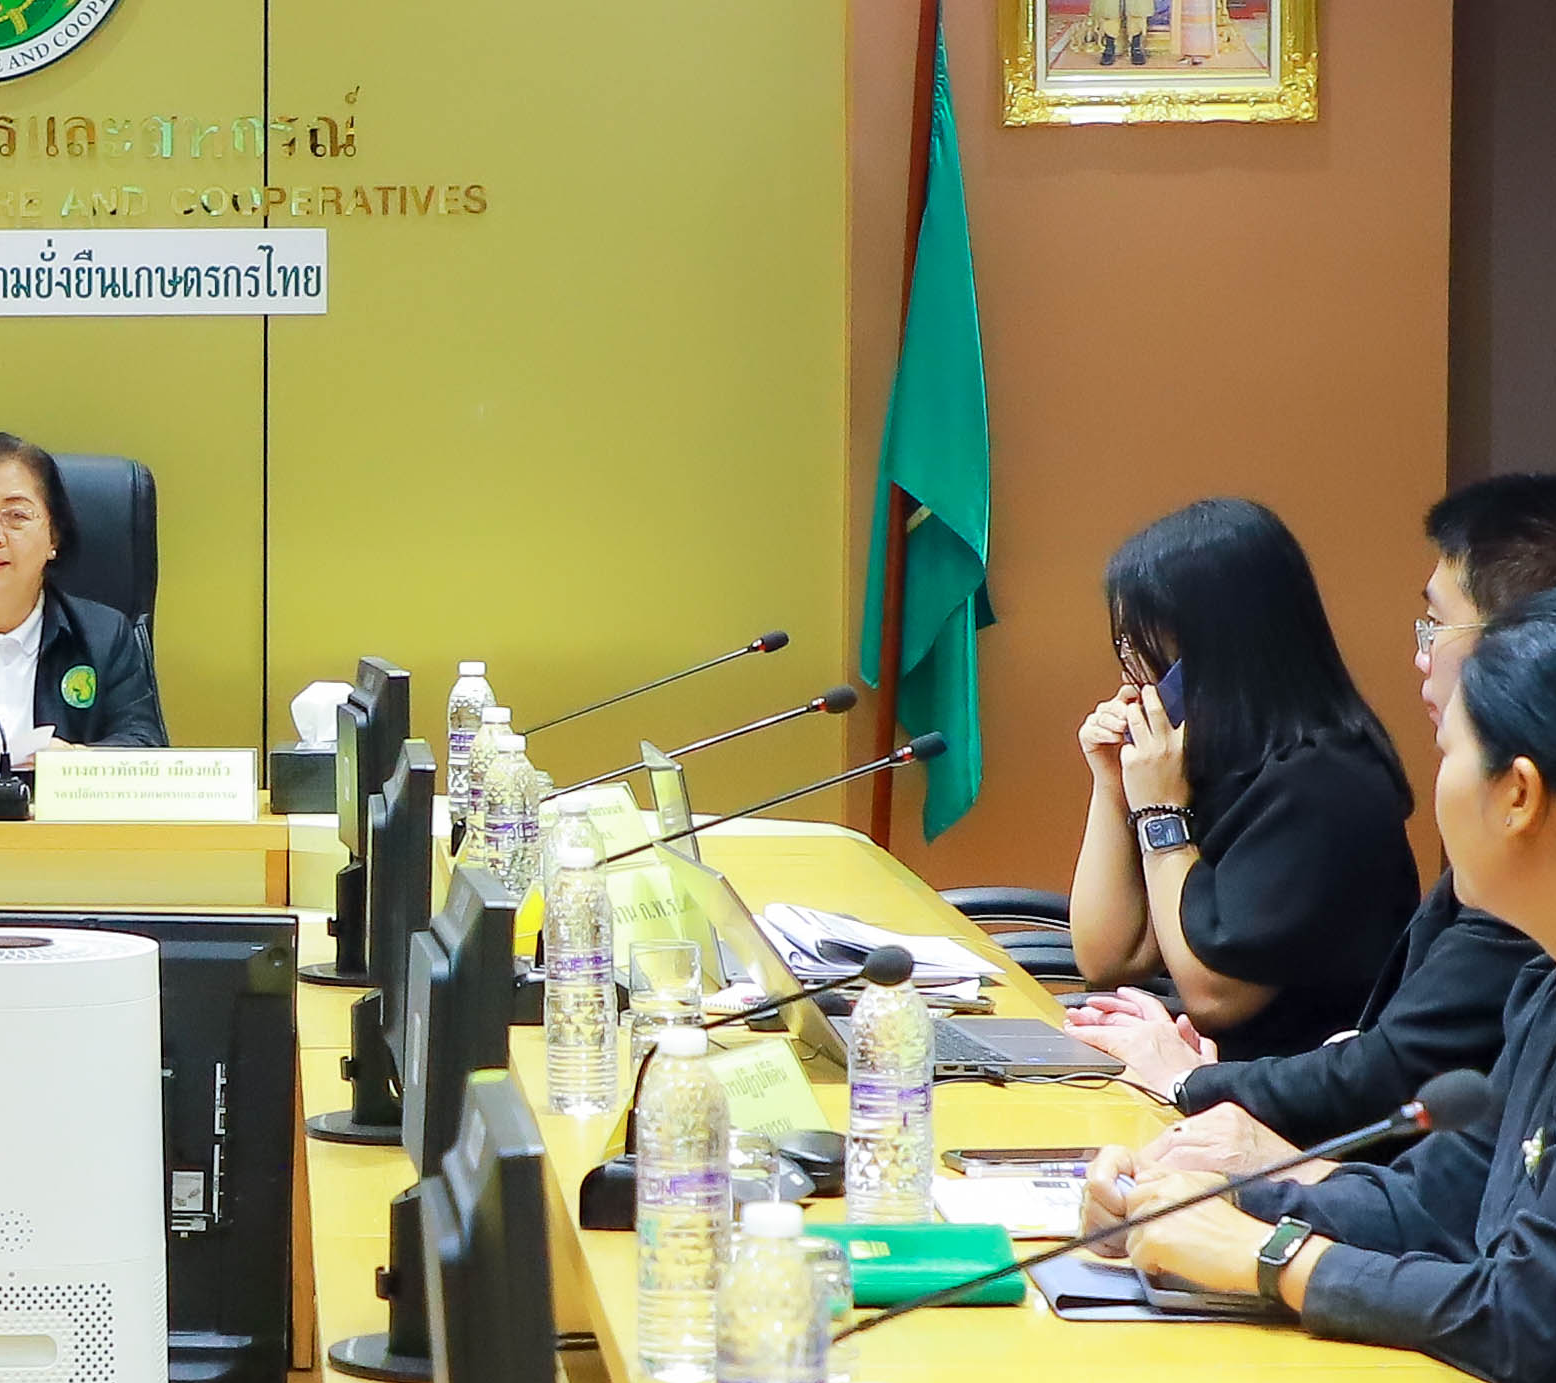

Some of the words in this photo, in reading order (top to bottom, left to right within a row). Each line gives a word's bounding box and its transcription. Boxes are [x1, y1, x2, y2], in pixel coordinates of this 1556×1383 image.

[8, 42, 50, 71] AND
[60, 185, 150, 217] AND
[170, 185, 488, 217] COOPERATIVES
